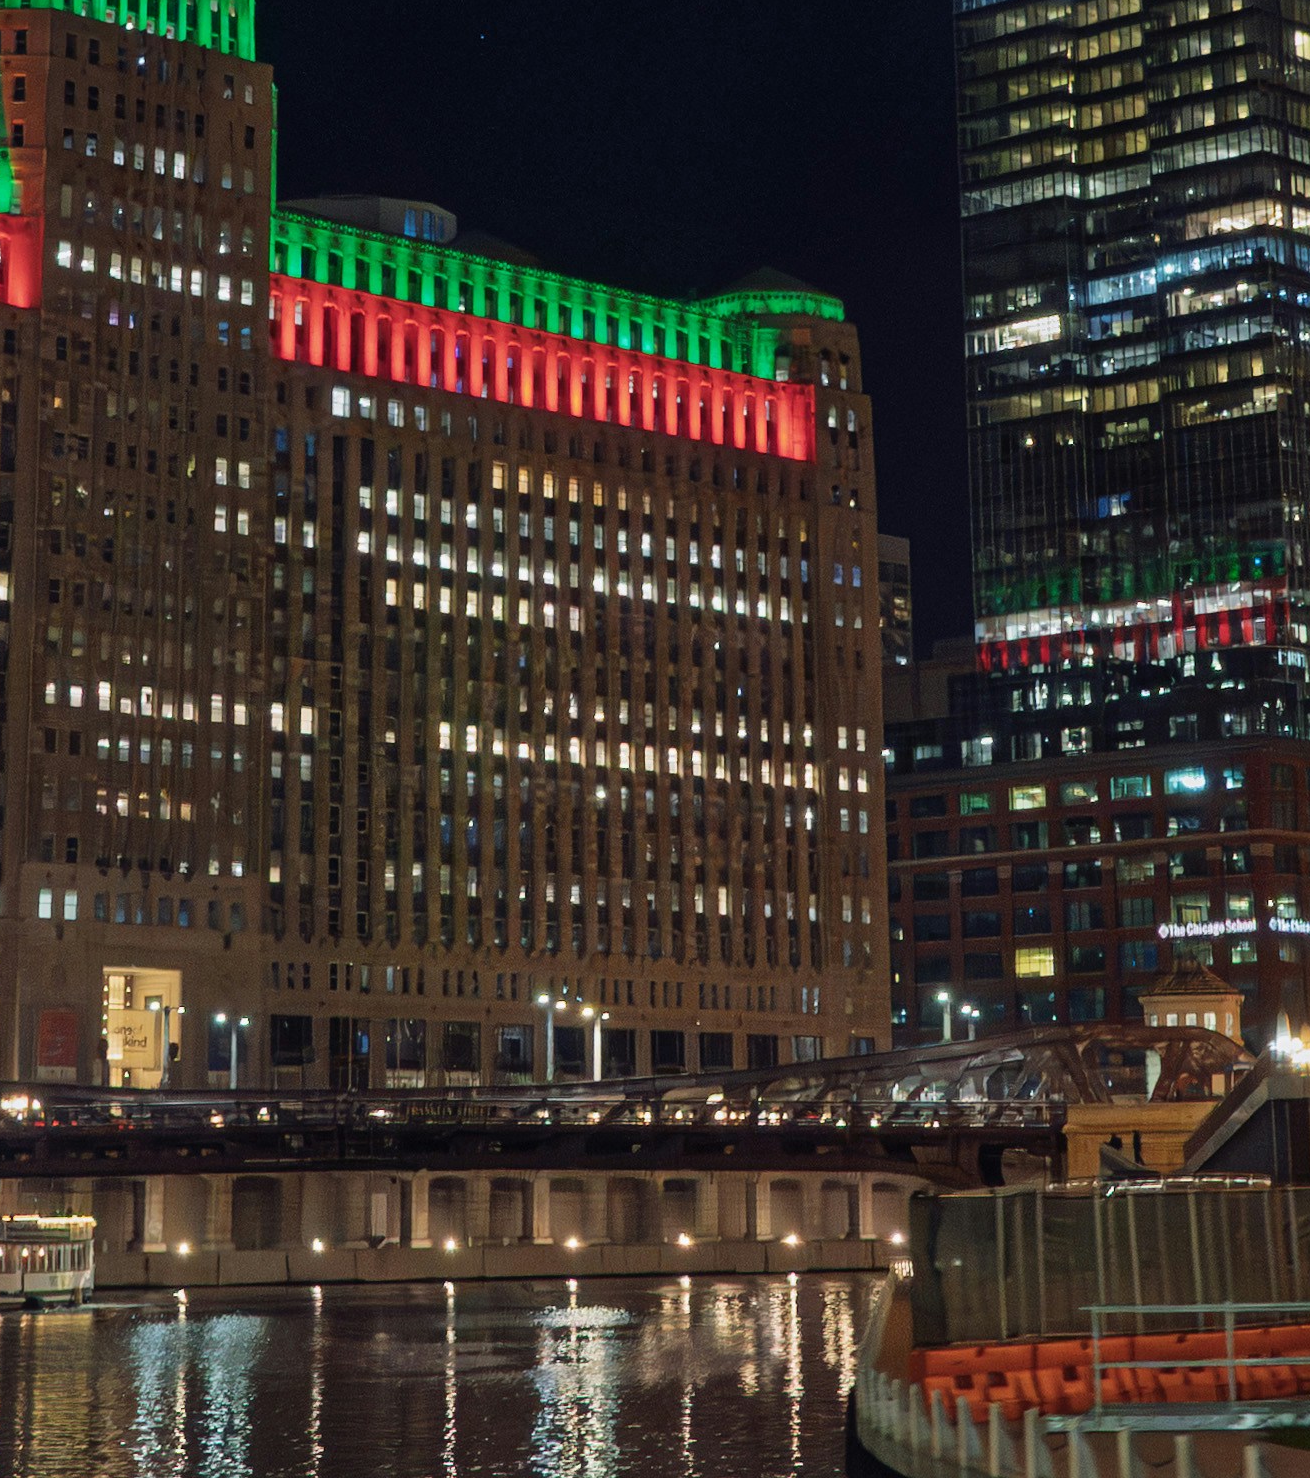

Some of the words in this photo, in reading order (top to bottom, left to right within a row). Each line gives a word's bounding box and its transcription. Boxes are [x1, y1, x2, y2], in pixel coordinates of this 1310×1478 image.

[1169, 923, 1185, 937] The
[1186, 921, 1225, 937] Chicago
[1226, 917, 1256, 934] School
[1277, 917, 1290, 932] The
